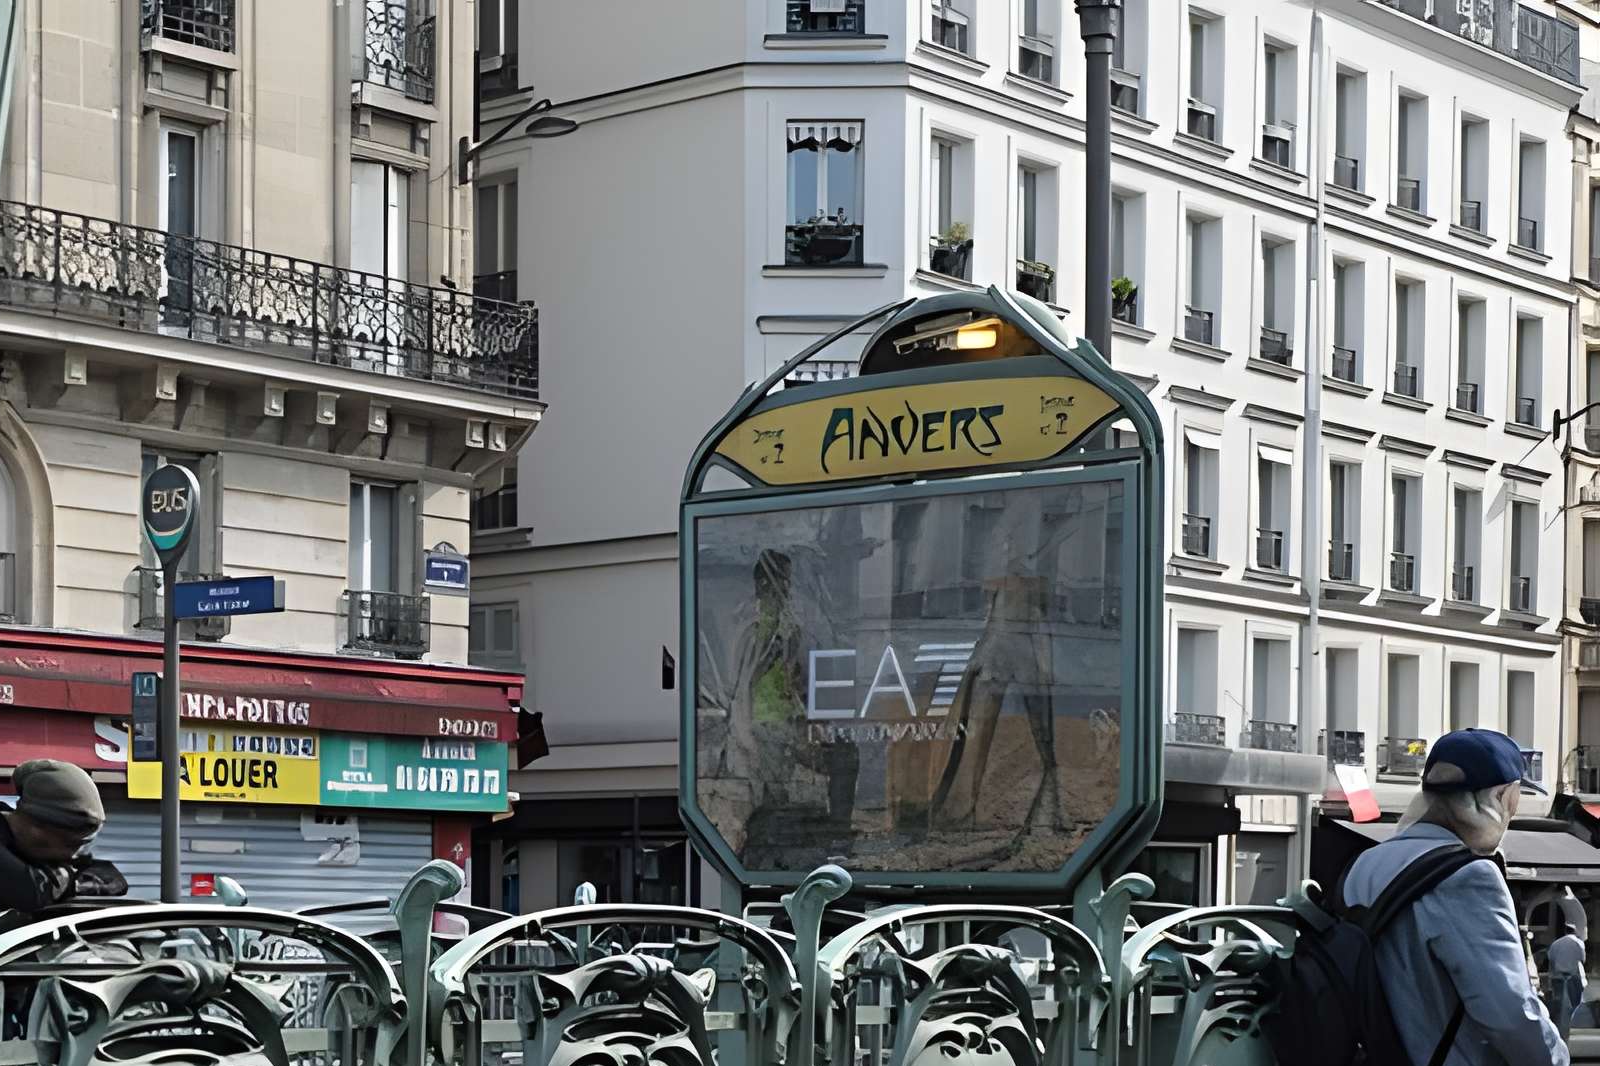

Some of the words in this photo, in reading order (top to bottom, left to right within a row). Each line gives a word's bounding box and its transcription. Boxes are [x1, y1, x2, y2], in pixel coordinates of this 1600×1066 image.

[821, 400, 1004, 474] ANVERS
[808, 642, 977, 719] EA7
[200, 757, 278, 788] LOUER
